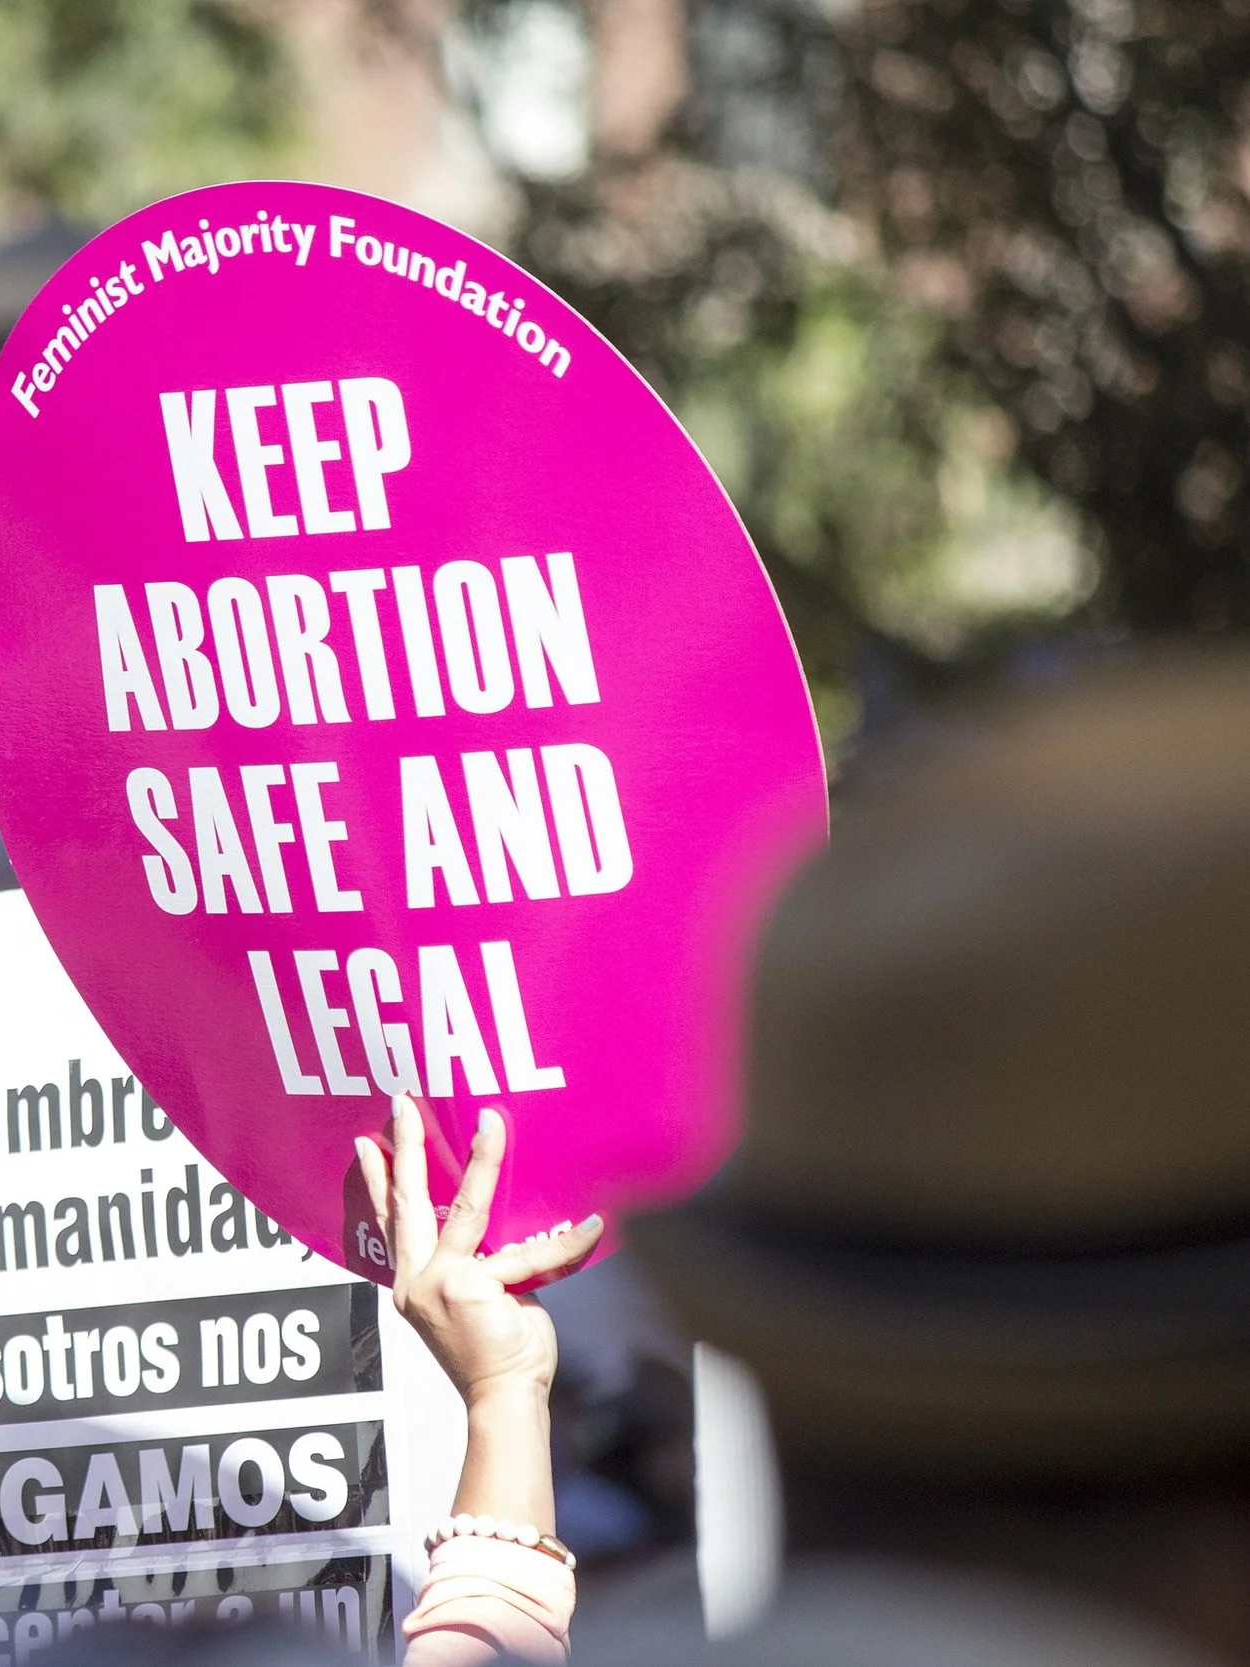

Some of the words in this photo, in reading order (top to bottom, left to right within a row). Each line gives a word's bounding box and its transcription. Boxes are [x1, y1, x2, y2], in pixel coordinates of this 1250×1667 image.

[11, 260, 145, 419] Feminist
[141, 210, 316, 282] Majority
[330, 215, 572, 379] Foundation
[159, 377, 411, 542] KEEP
[93, 552, 601, 733] ABORTION
[125, 762, 362, 917] SAFE
[400, 743, 634, 909] AND
[247, 941, 567, 1098] LEGAL
[200, 1308, 322, 1387] nos
